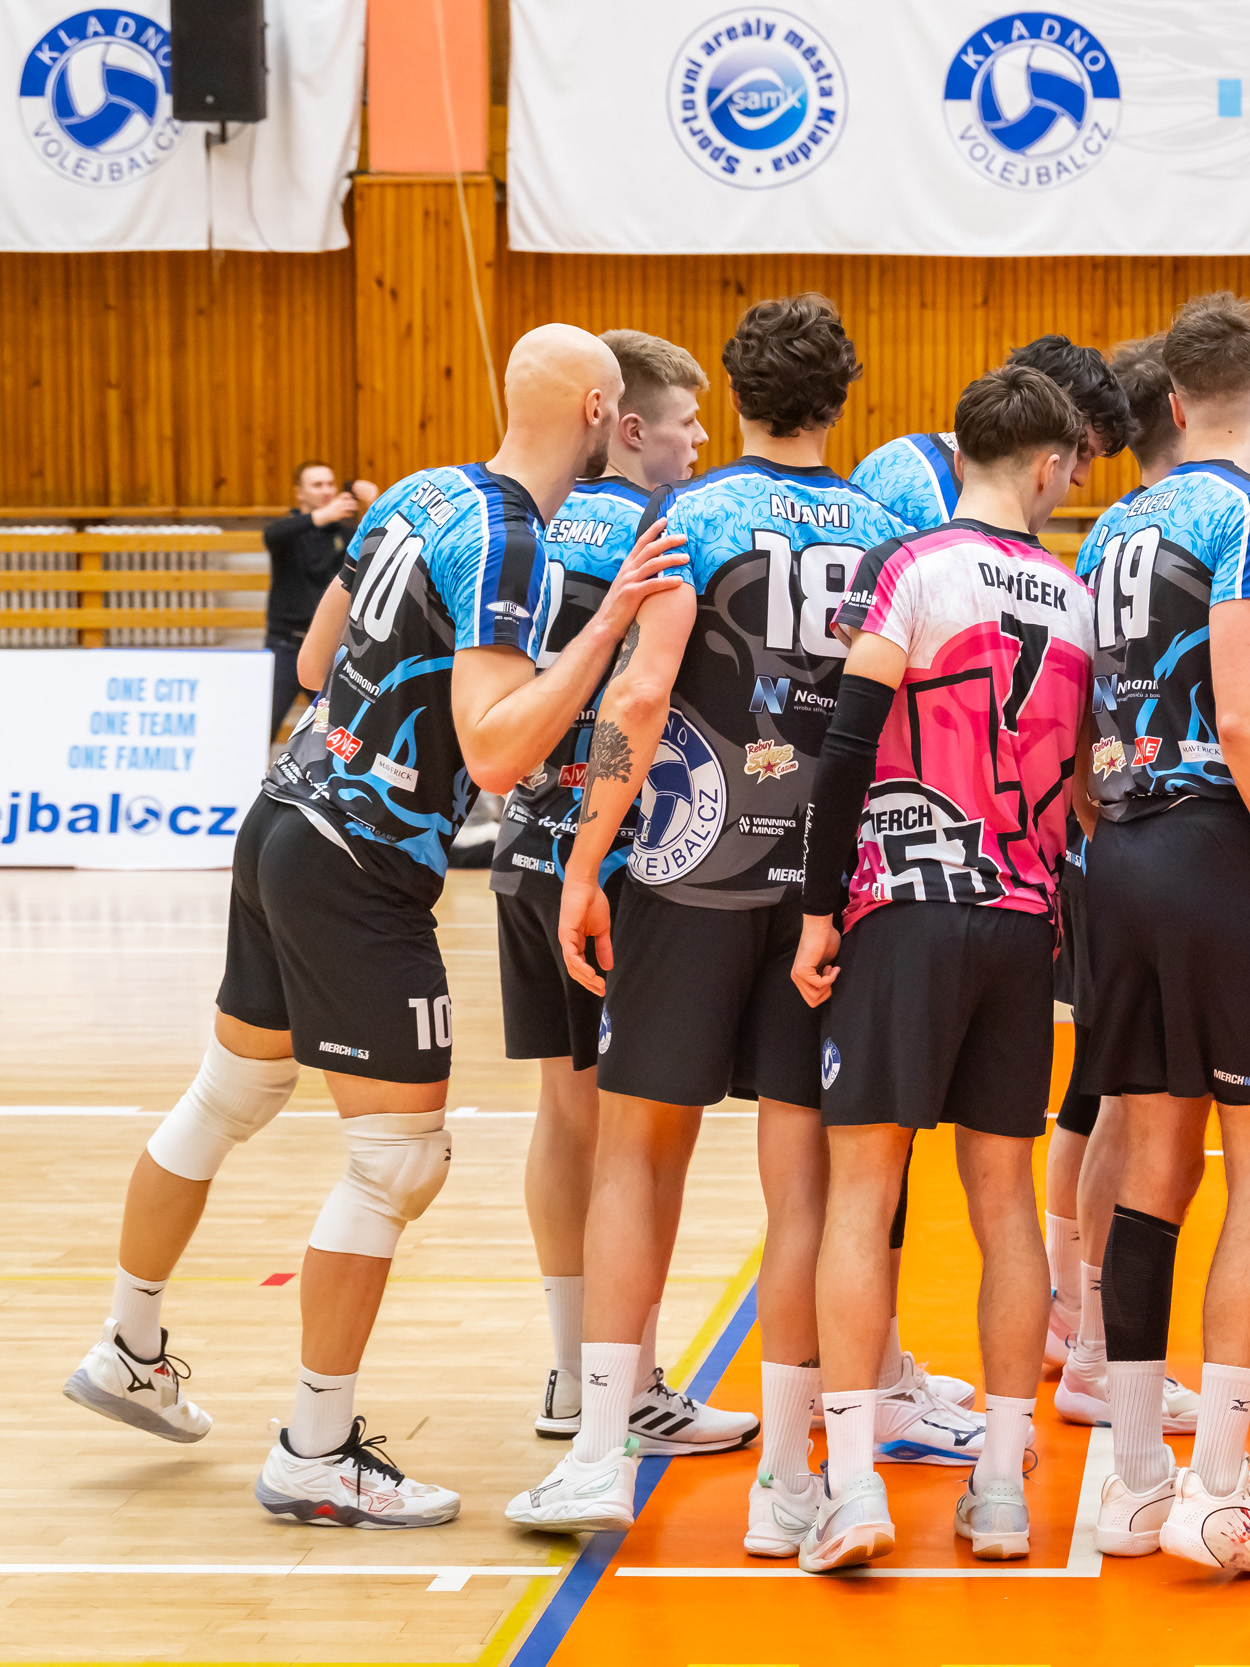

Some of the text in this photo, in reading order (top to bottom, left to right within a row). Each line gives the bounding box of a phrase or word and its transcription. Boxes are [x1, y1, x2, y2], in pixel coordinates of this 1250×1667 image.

[960, 18, 1106, 72] KLADNO
[772, 107, 836, 172] Kladna
[769, 493, 850, 529] ADAMI
[350, 510, 425, 642] 10
[751, 528, 868, 659] 18
[1096, 524, 1161, 649] 19
[106, 677, 200, 703] ONE CITY
[999, 610, 1051, 737] 7
[90, 711, 196, 737] ONE TEAM
[67, 745, 195, 771] ONE FAMILY
[1182, 745, 1222, 757] MAVERICK
[752, 818, 796, 829] WINNING
[752, 827, 785, 837] MINDS
[768, 868, 806, 884] MERC
[408, 994, 452, 1050] 10
